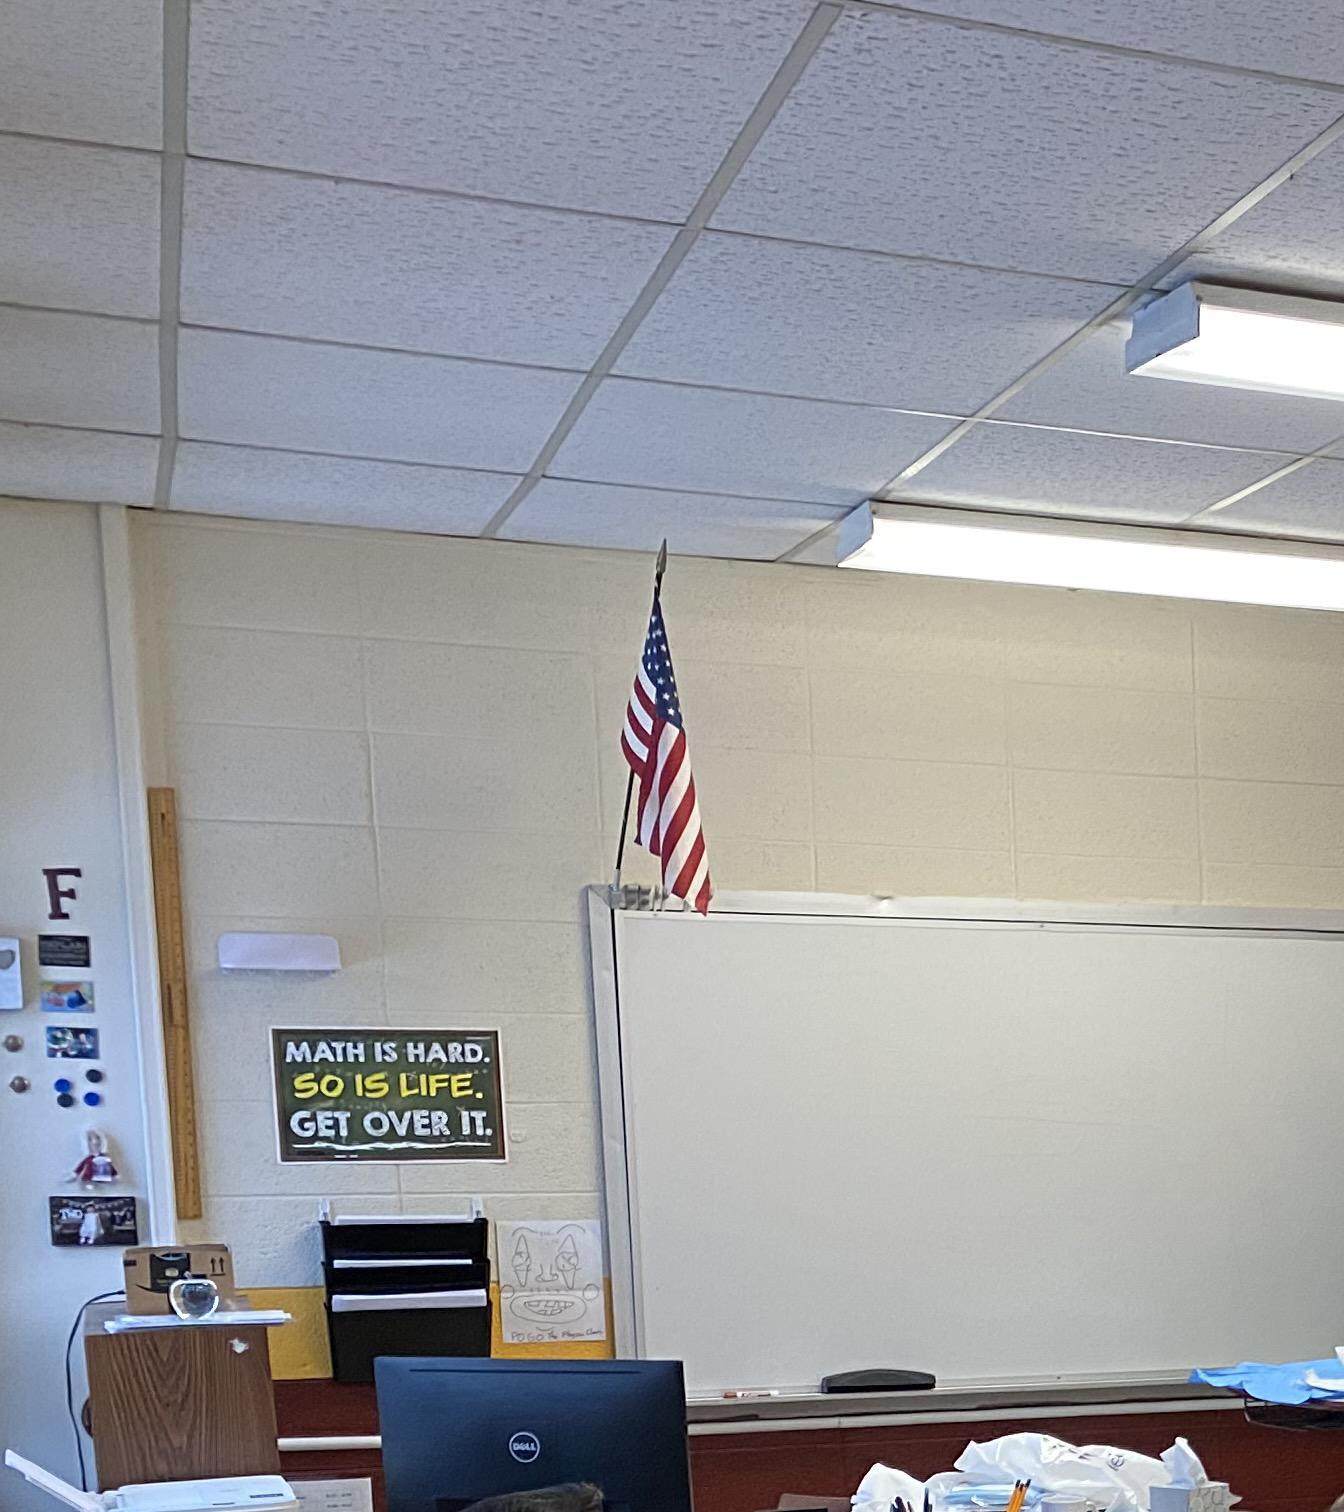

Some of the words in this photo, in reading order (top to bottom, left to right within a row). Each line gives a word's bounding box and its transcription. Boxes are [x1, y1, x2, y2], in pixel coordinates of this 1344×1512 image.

[42, 867, 82, 920] F
[286, 1041, 366, 1063] MATH
[374, 1041, 398, 1063] IS
[406, 1041, 491, 1064] HARD.
[293, 1072, 345, 1099] SO
[354, 1072, 390, 1099] IS
[399, 1072, 484, 1099] LIFE.
[290, 1110, 351, 1137] GET
[362, 1109, 451, 1137] OVER
[460, 1110, 493, 1137] IT.
[512, 1442, 537, 1451] DELL
